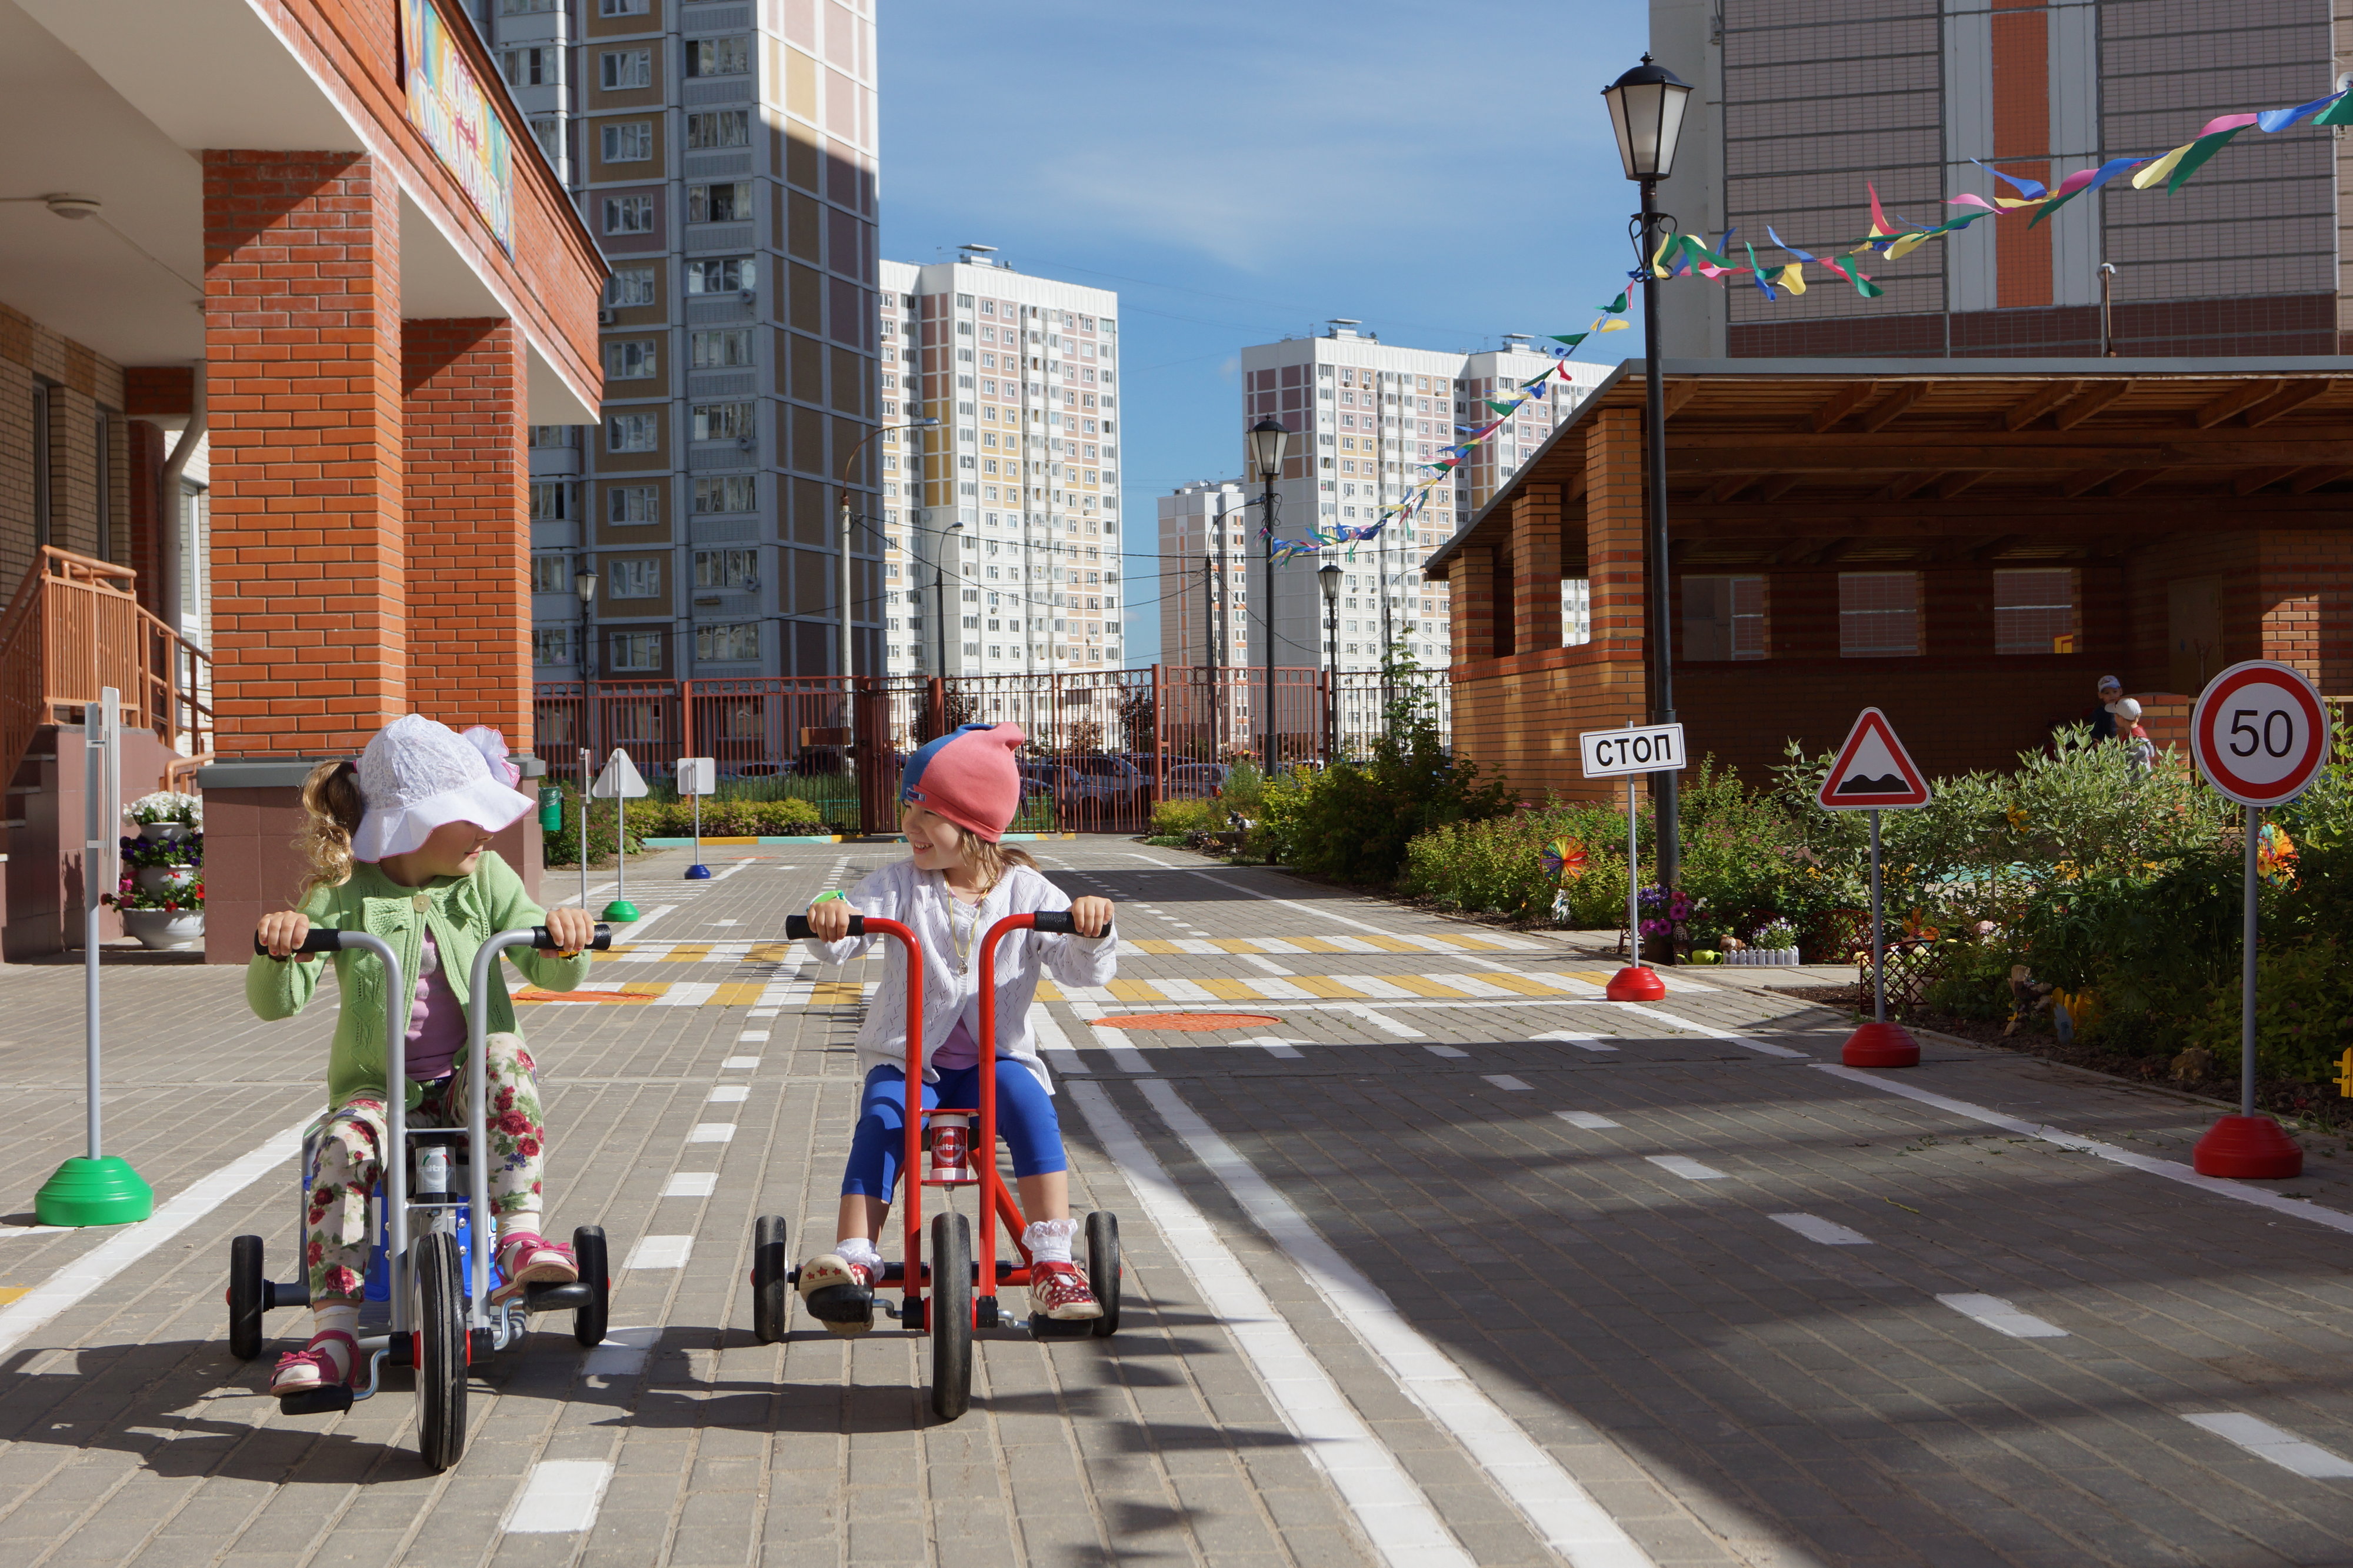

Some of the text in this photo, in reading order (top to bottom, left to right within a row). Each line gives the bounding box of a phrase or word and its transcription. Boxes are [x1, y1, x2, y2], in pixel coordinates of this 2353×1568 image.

[442, 38, 484, 149] ДОБРО
[1596, 734, 1671, 767] СТОП
[2229, 709, 2293, 758] 50
